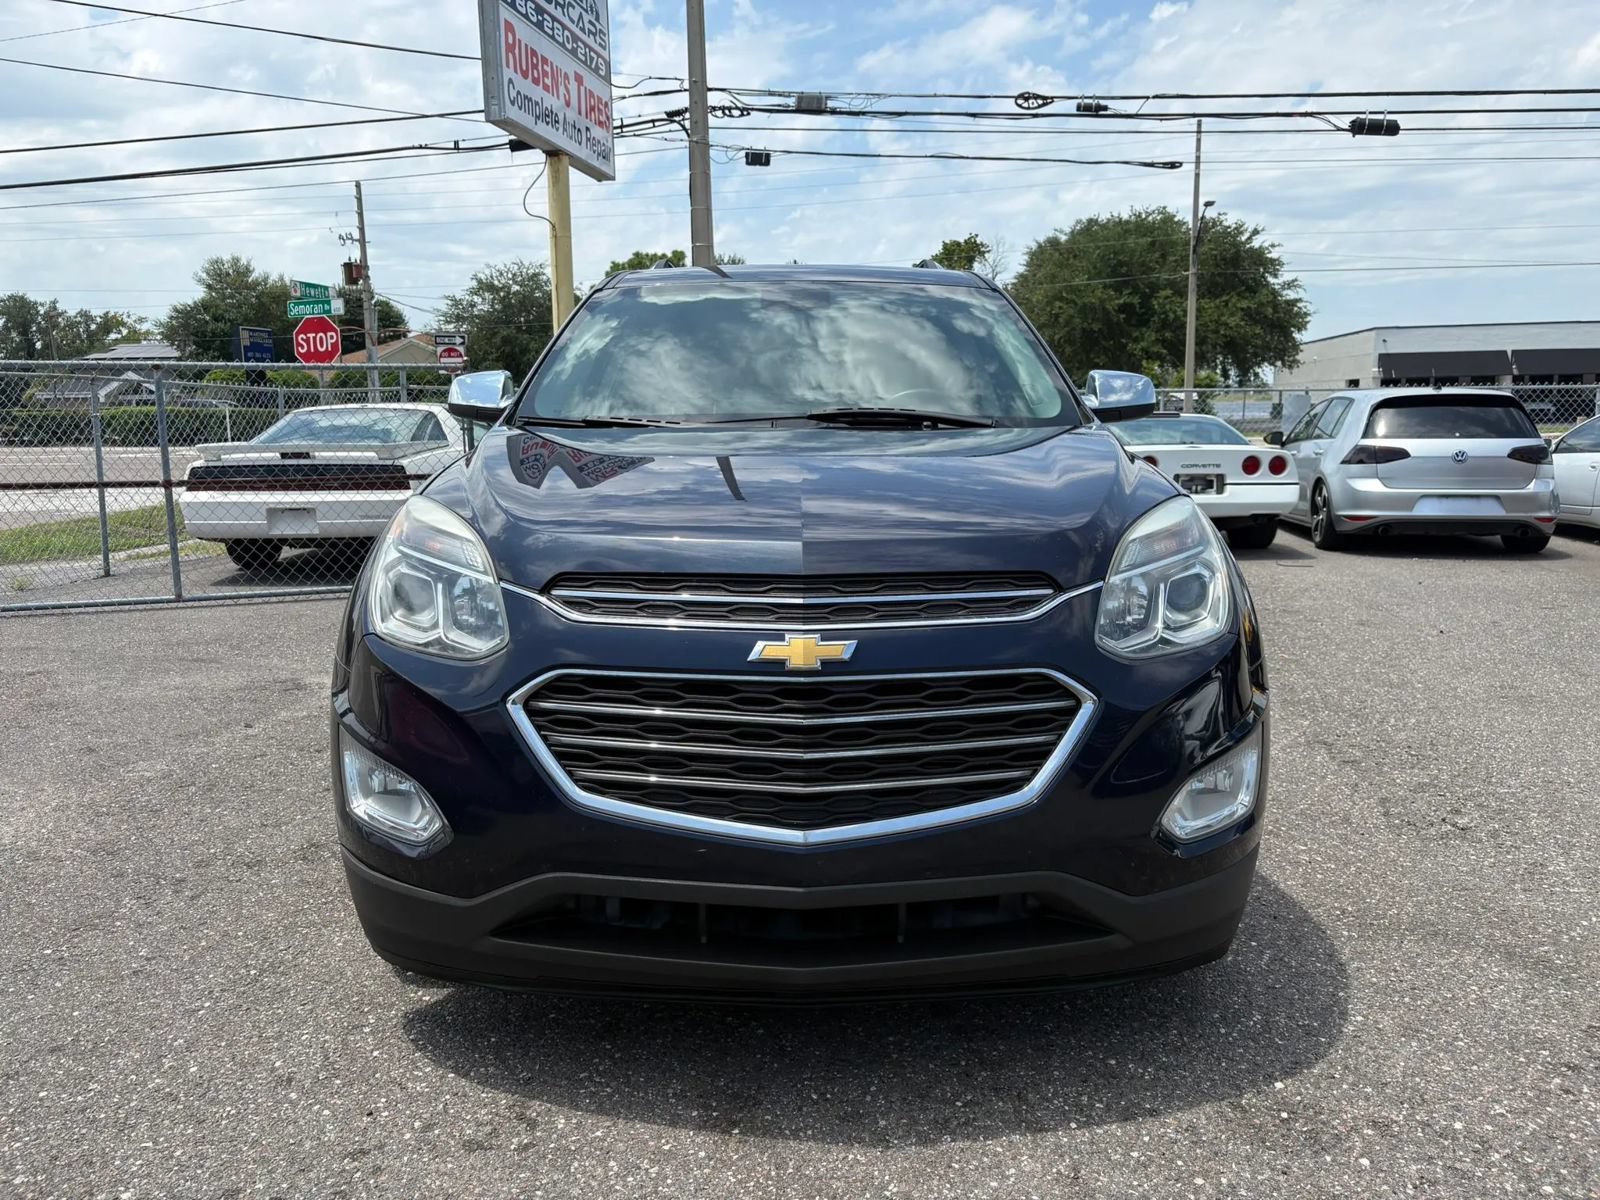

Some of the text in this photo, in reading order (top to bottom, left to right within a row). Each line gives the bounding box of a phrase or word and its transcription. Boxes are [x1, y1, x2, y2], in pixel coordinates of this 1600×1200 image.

[504, 18, 611, 134] RUBEN'S TIRES
[507, 77, 612, 162] Complete Auto Repair
[290, 303, 323, 315] Semoran
[298, 332, 337, 353] STOP
